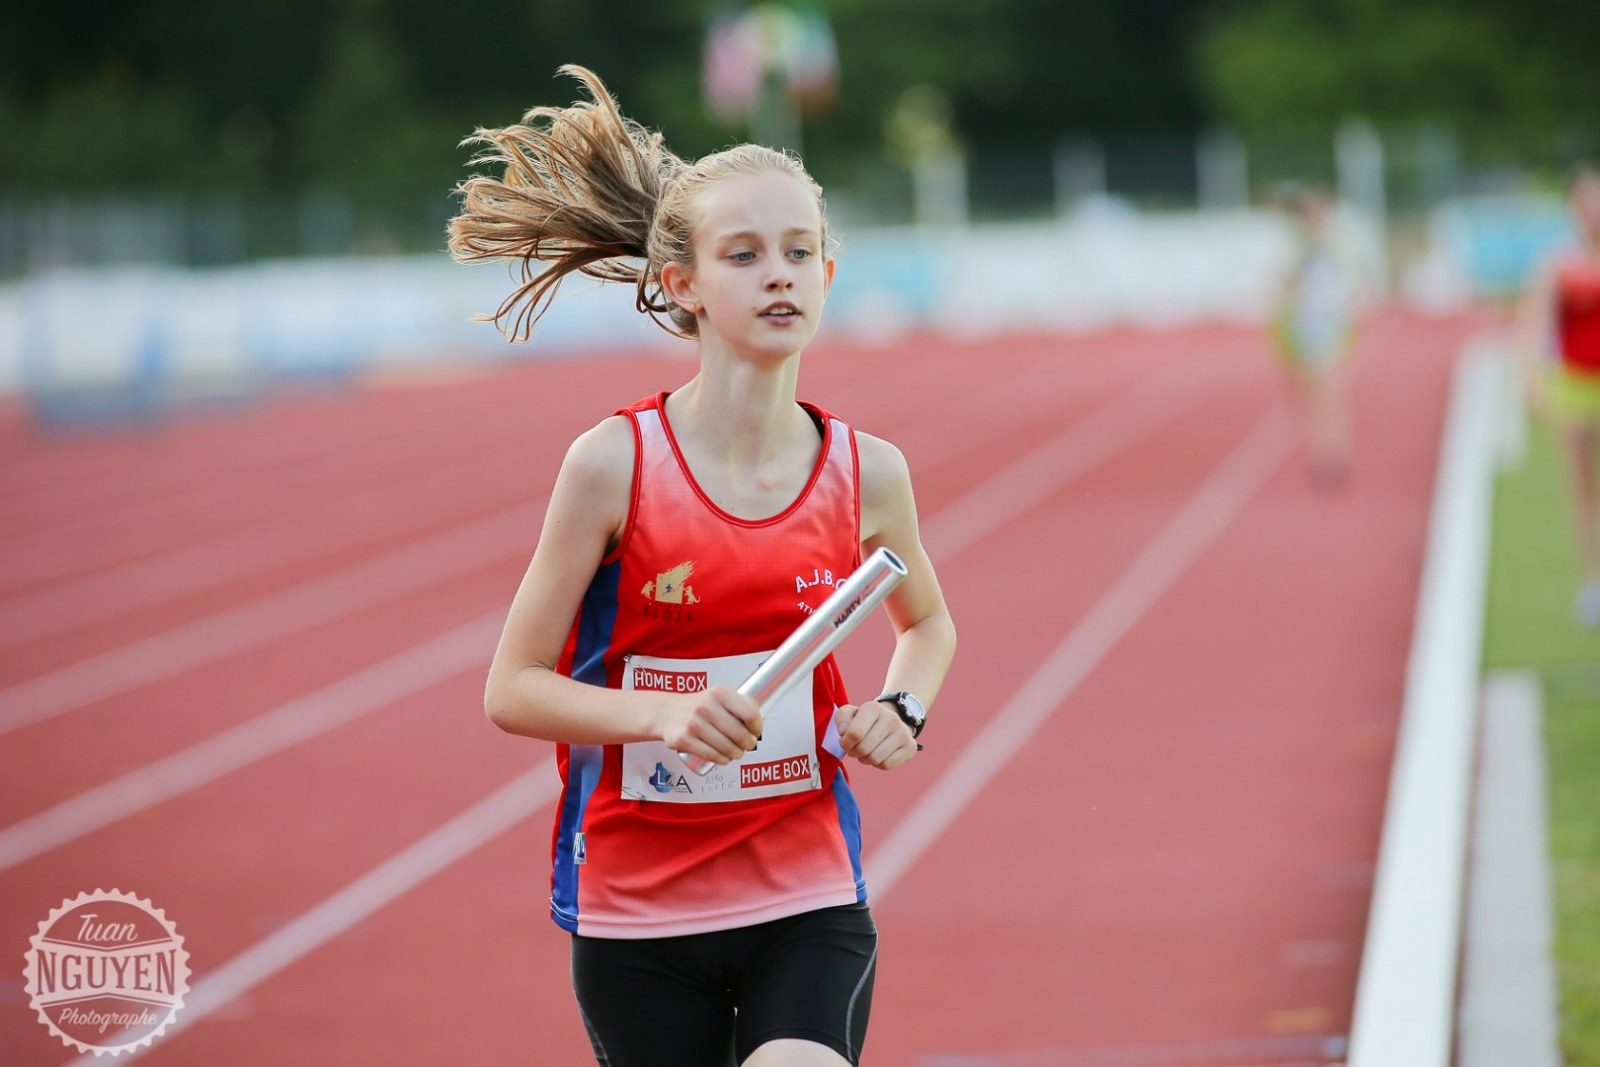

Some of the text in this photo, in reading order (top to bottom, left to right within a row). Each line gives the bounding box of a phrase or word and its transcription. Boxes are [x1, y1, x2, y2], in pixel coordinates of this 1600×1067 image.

[634, 672, 706, 692] HOME BOX
[741, 758, 809, 784] HOME BOX
